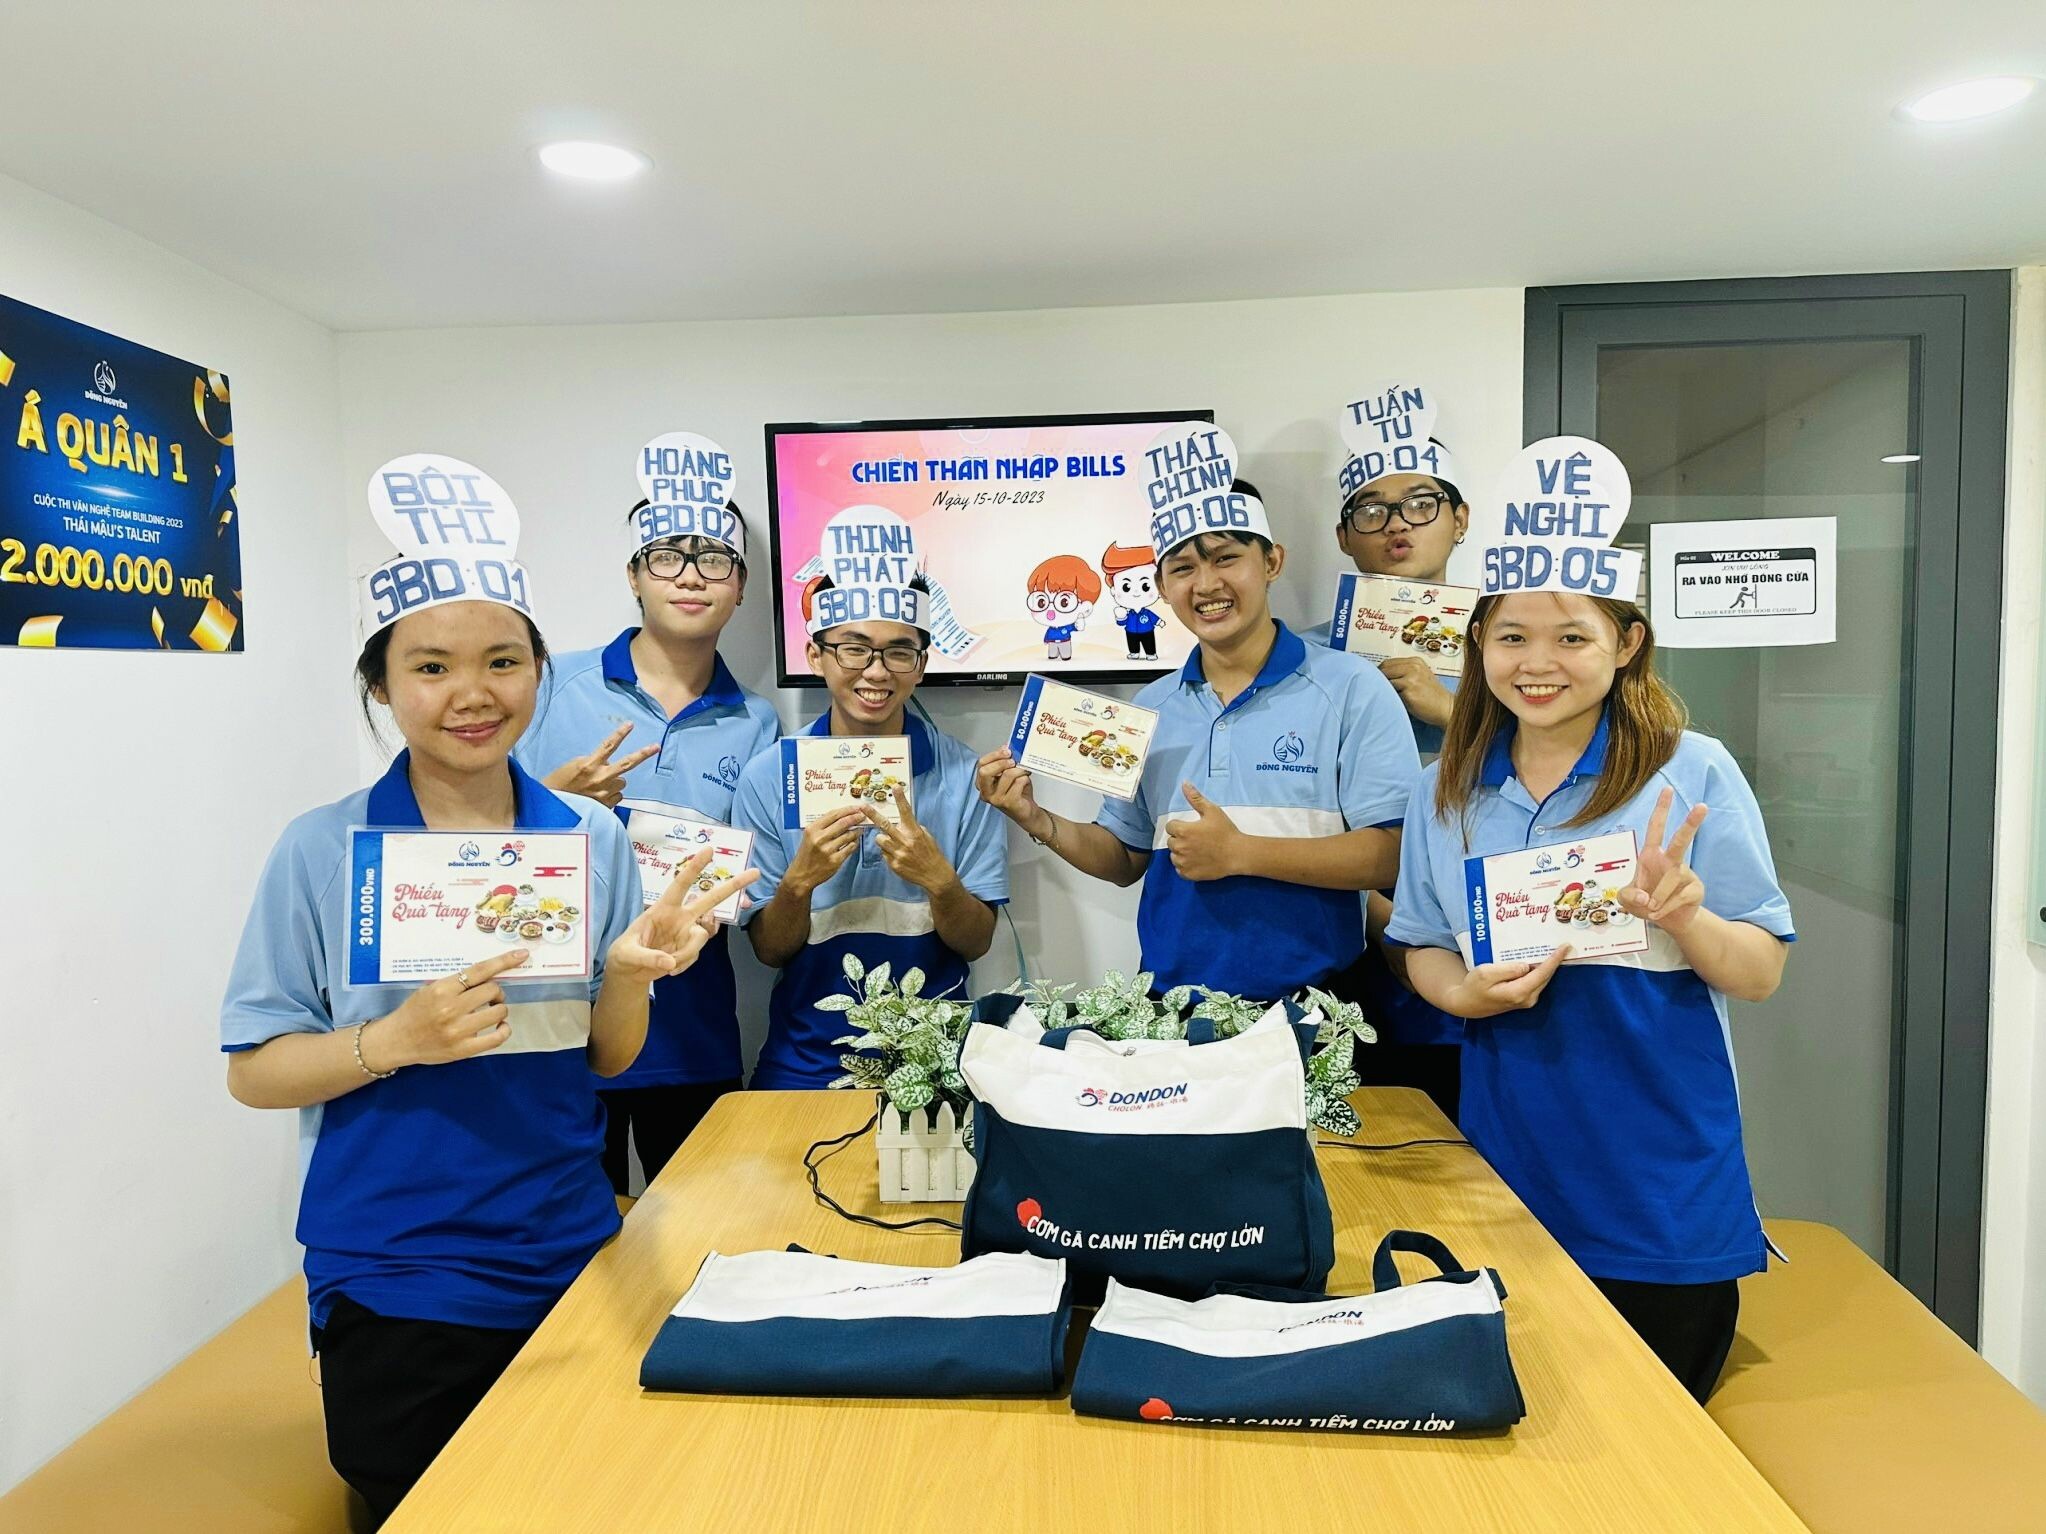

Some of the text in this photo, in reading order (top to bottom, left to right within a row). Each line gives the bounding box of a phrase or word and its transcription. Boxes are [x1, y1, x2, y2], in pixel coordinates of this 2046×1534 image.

[1346, 384, 1424, 425] TUẤN
[17, 389, 188, 484] Á QUÂN 1
[644, 445, 732, 481] HOÀNG
[996, 454, 1059, 482] NHẬP
[1066, 455, 1126, 478] BILLS
[1145, 431, 1224, 478] THÁI
[1338, 445, 1439, 501] SBD:04
[652, 477, 724, 505] PHÚC
[932, 490, 1045, 511] Ngày 15-10-2023
[33, 493, 184, 529] CUỘC THI VĂN NGHỆ TEAM BUILDING 2023
[638, 504, 737, 547] SBD:02
[1150, 494, 1249, 556] SBD:06
[1504, 502, 1611, 539] NGHI
[63, 515, 161, 544] THÁI MẬU'S TALENT
[393, 507, 506, 545] THI
[827, 524, 914, 557] THỊNH
[0, 537, 214, 599] 2.000.000 vnđ
[833, 553, 909, 584] PHÁT
[1485, 545, 1622, 596] SBD:05
[1710, 550, 1780, 562] WELCOME
[369, 558, 531, 625] SBD:01
[1682, 576, 1696, 586] RA
[818, 587, 918, 628] SBD:03
[1355, 618, 1375, 630] Quà
[976, 673, 1008, 681] DARLING
[1036, 723, 1056, 736] Quà
[1281, 764, 1319, 774] NGUYÊN
[804, 780, 823, 792] Quà
[394, 882, 445, 902] Phiếu
[1495, 889, 1530, 907] Phiếu
[392, 902, 471, 930] Quà tặng
[1496, 906, 1520, 922] Quà
[1108, 1104, 1143, 1112] CHOLON
[1109, 1083, 1188, 1105] DONDON
[1026, 1215, 1060, 1243] CƠM
[1060, 1230, 1083, 1249] GÀ
[1088, 1233, 1138, 1250] CANH
[1188, 1231, 1228, 1253] CHỢ
[1230, 1222, 1265, 1248] LỚN
[1412, 1412, 1456, 1431] LỚN
